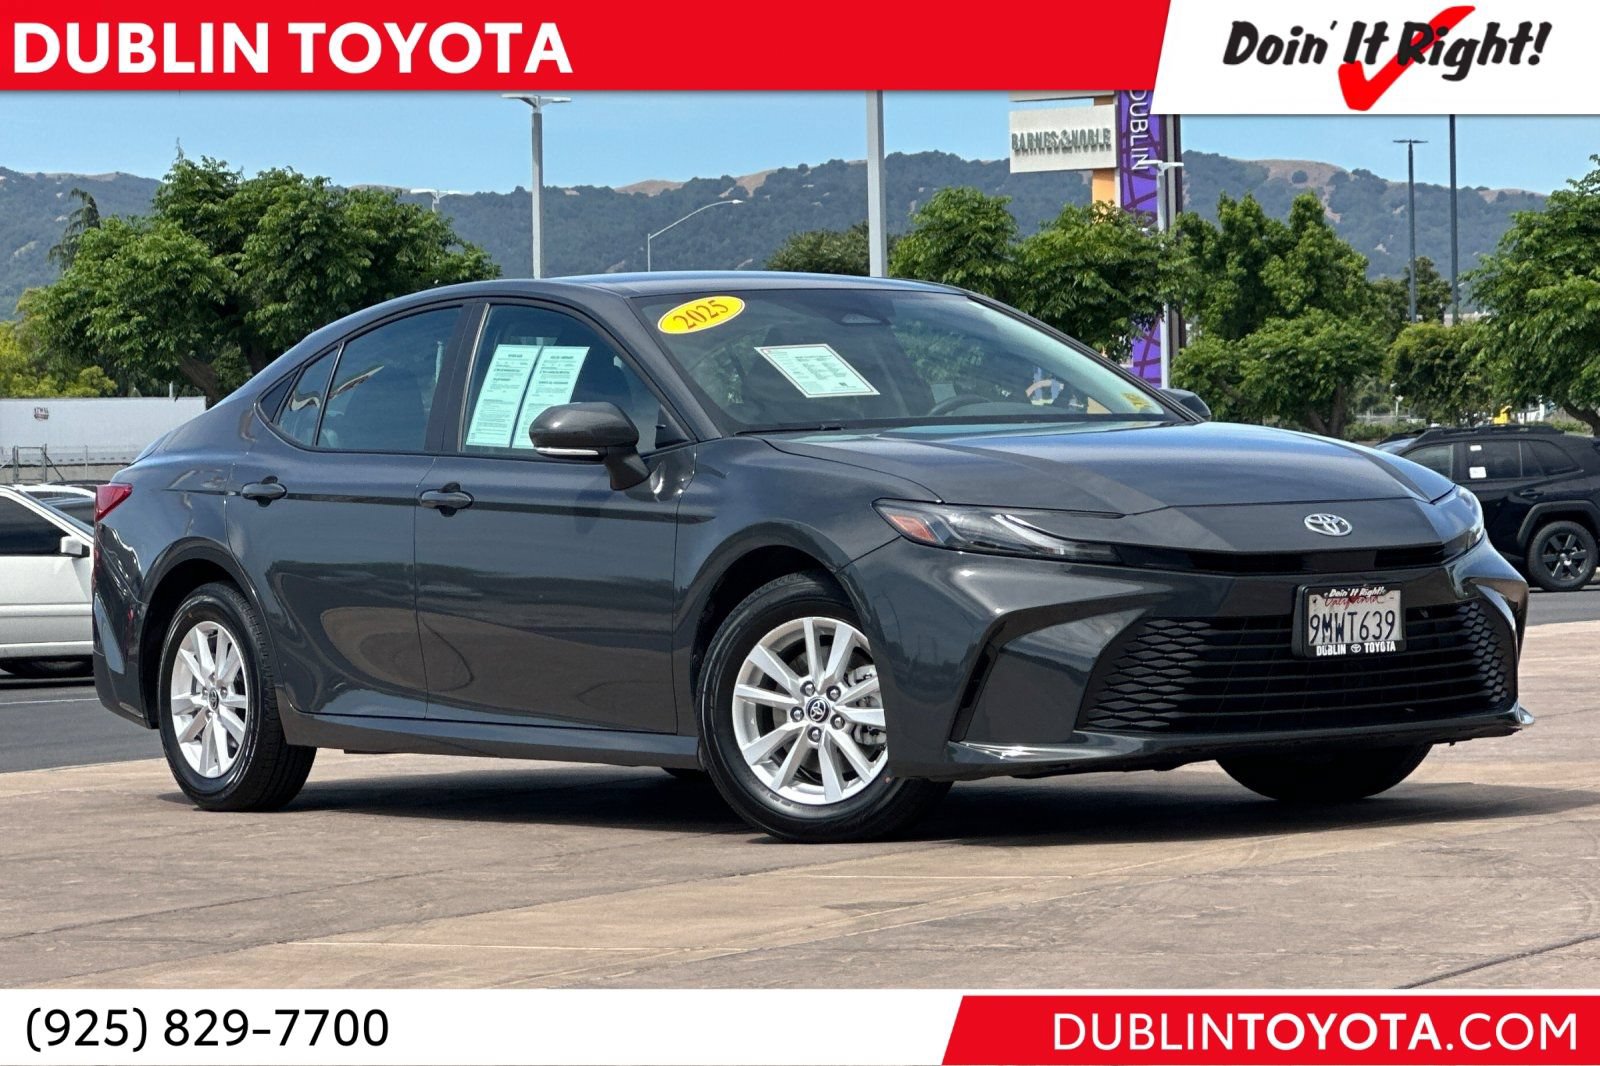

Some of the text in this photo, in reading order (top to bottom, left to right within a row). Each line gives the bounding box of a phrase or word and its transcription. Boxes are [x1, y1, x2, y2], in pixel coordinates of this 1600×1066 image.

[672, 300, 729, 329] 2025
[1309, 610, 1396, 644] 9MWT639
[1316, 640, 1396, 656] DUBLIN TOYOTA
